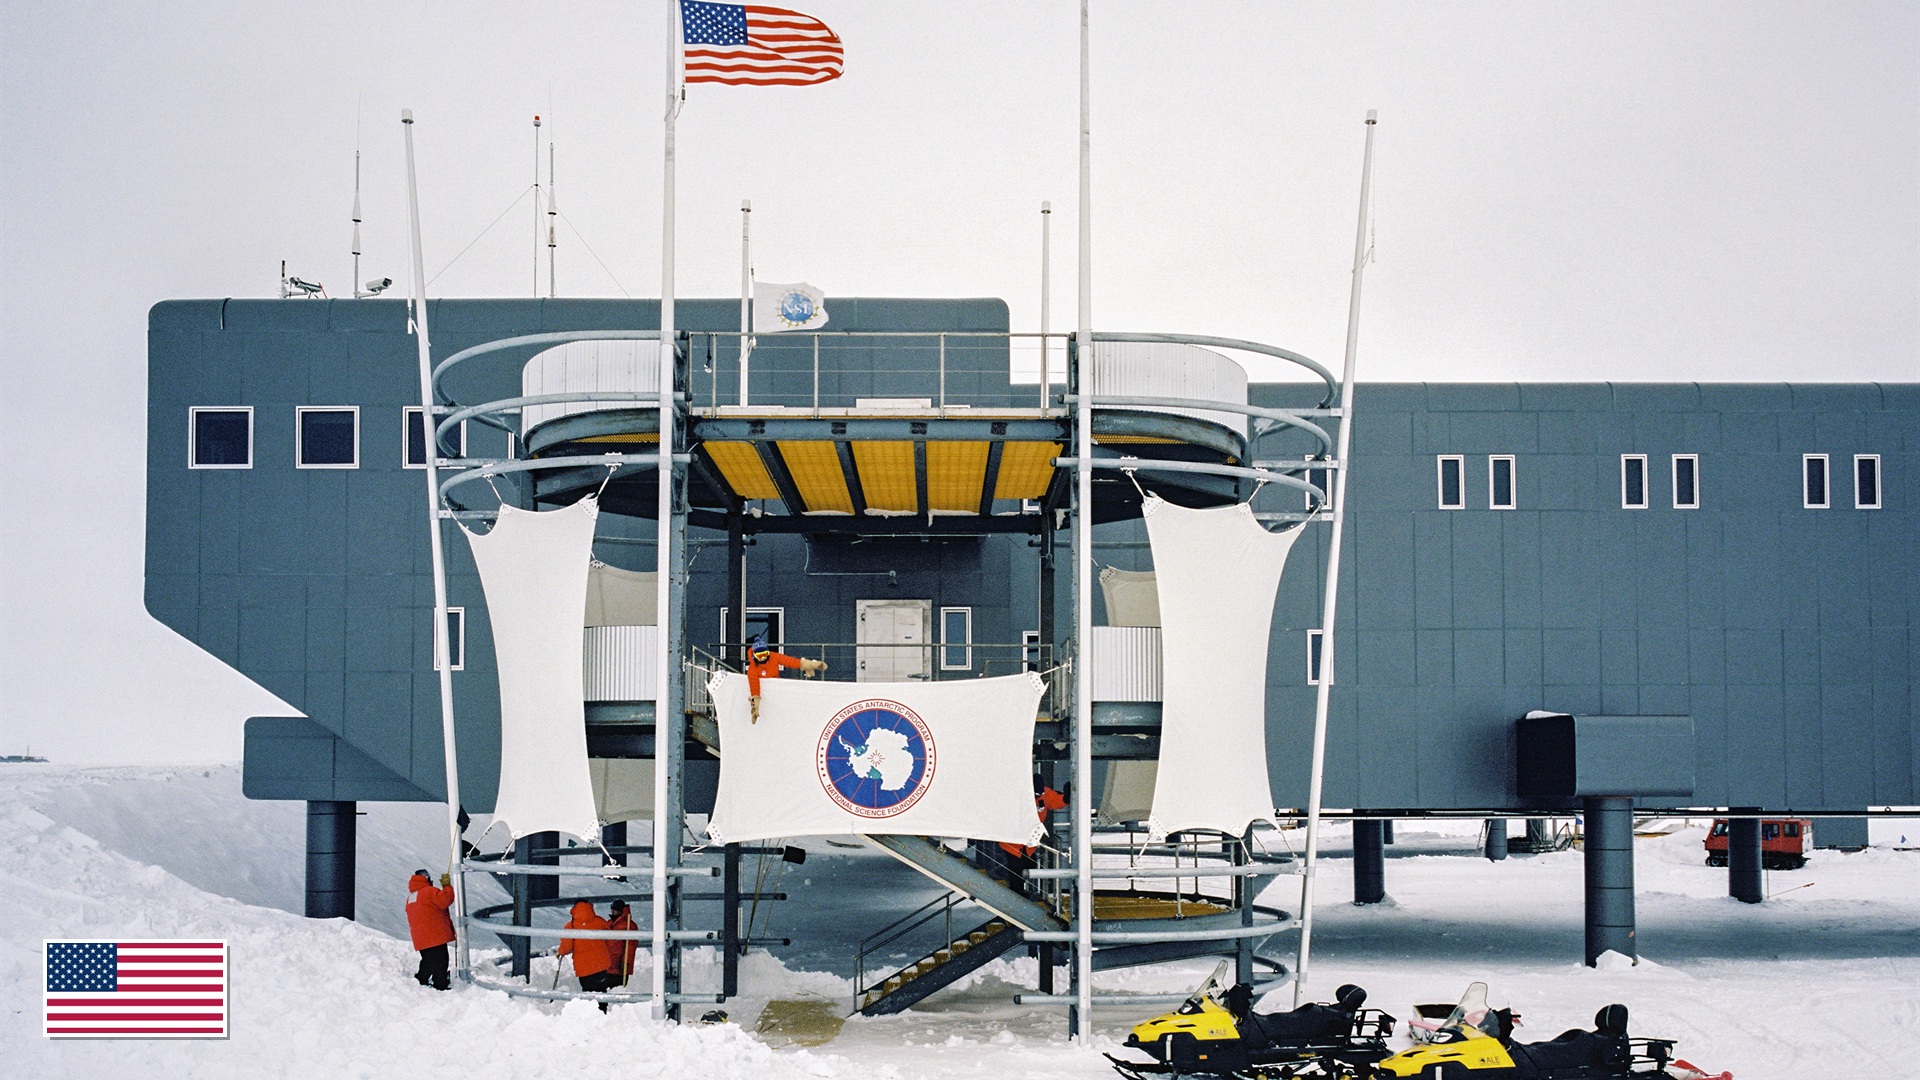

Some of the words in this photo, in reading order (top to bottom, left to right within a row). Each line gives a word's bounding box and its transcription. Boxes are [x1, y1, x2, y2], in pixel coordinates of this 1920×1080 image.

[823, 717, 841, 741] UNITED
[840, 704, 864, 719] STATES
[865, 701, 905, 714] ANTARCTIC
[904, 710, 930, 742] PROGRAM
[826, 783, 853, 811] NATIONAL
[854, 806, 887, 816] SCIENCE
[887, 784, 926, 815] FOUNDATION
[1215, 1028, 1228, 1036] ALE
[1486, 1056, 1500, 1064] ALE
